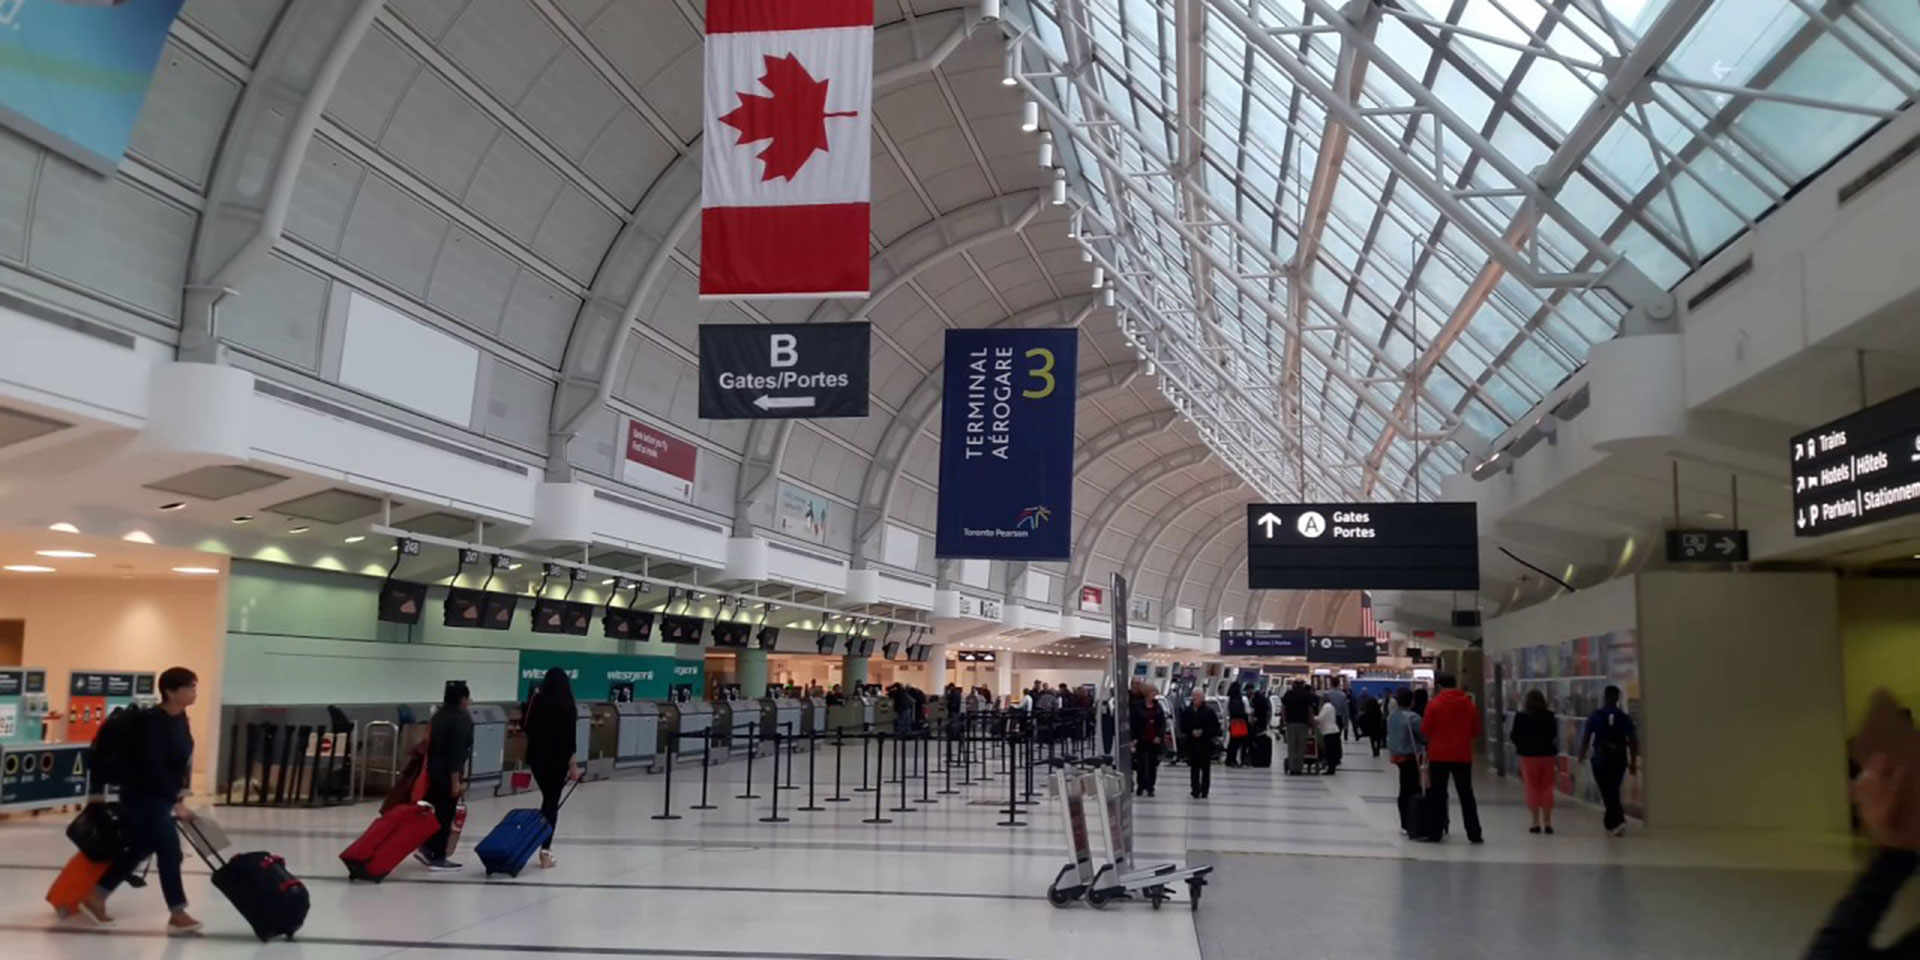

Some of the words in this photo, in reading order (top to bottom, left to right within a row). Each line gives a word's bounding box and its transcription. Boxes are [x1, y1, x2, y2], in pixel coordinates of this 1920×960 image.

[770, 333, 799, 368] B
[719, 371, 849, 389] Gates/Portes
[1022, 347, 1056, 399] 3
[965, 347, 988, 460] TERMINAL
[987, 347, 1013, 460] AÉROGARE
[1819, 431, 1846, 451] Trains
[1821, 463, 1849, 486] Hotels
[1856, 451, 1887, 475] Hôtels
[1822, 498, 1857, 521] Parking
[1863, 482, 1920, 510] Stationnem
[1333, 511, 1370, 523] Gates
[963, 527, 995, 537] Toronto
[995, 528, 1029, 538] Pearson
[1333, 526, 1376, 539] Portes
[403, 540, 419, 554] 248
